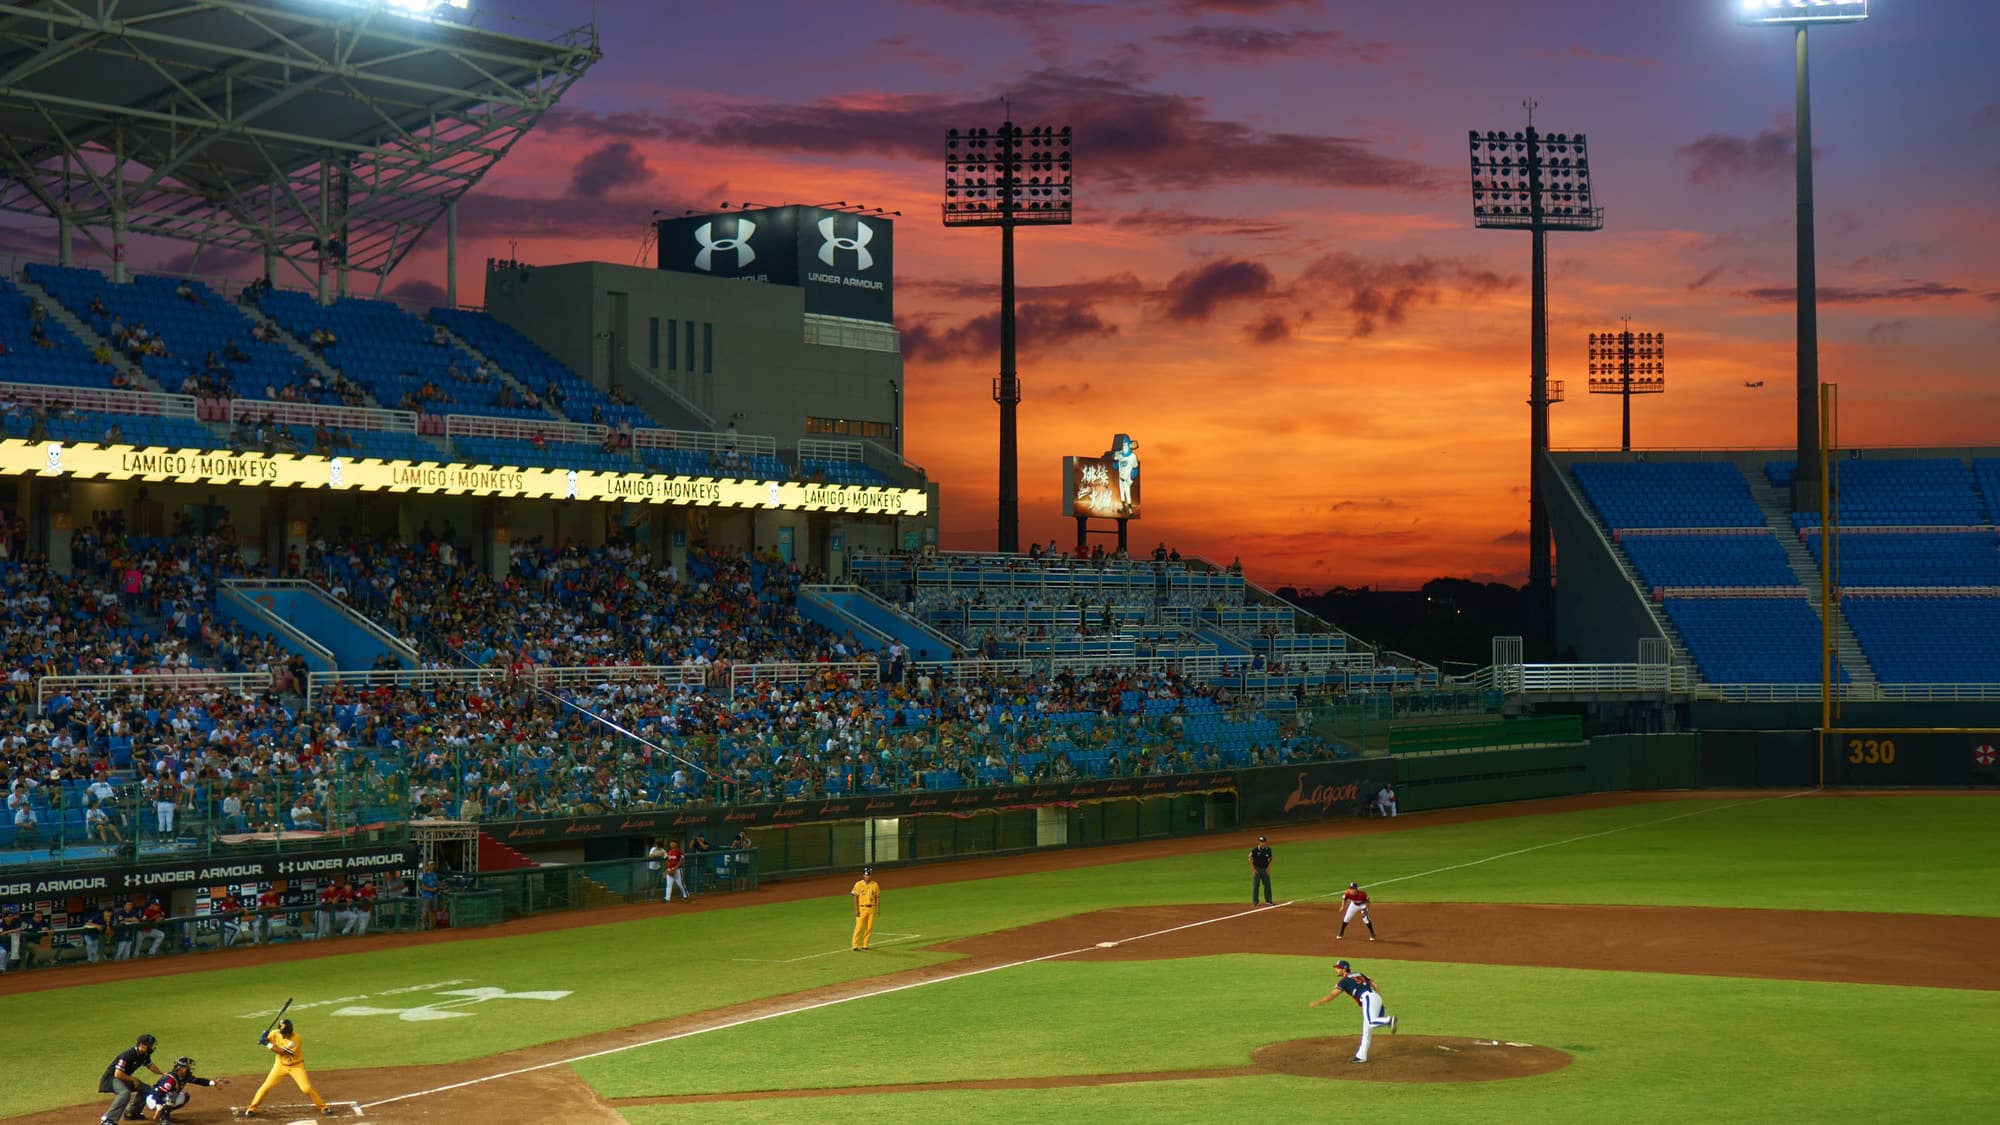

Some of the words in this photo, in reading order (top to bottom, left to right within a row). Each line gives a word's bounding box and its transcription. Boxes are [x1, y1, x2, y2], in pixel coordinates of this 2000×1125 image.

[808, 272, 841, 285] UNDER
[843, 277, 883, 290] ARMOUR
[123, 454, 187, 474] LAMIGO
[200, 457, 278, 478] MONKEYS
[393, 467, 447, 486] LAMIGO
[458, 471, 523, 489] MONKEYS
[607, 479, 654, 496] LAMIGO
[664, 482, 720, 499] MONKEYS
[804, 490, 845, 505] LAMIGO
[853, 492, 902, 508] MONKEYS
[1849, 740, 1895, 764] 330
[1282, 771, 1358, 813] Lagoon
[296, 858, 343, 872] UNDER
[346, 853, 404, 867] ARMOUR
[144, 870, 195, 884] UNDER
[199, 864, 262, 879] ARMOUR
[36, 877, 105, 893] ARMOUR
